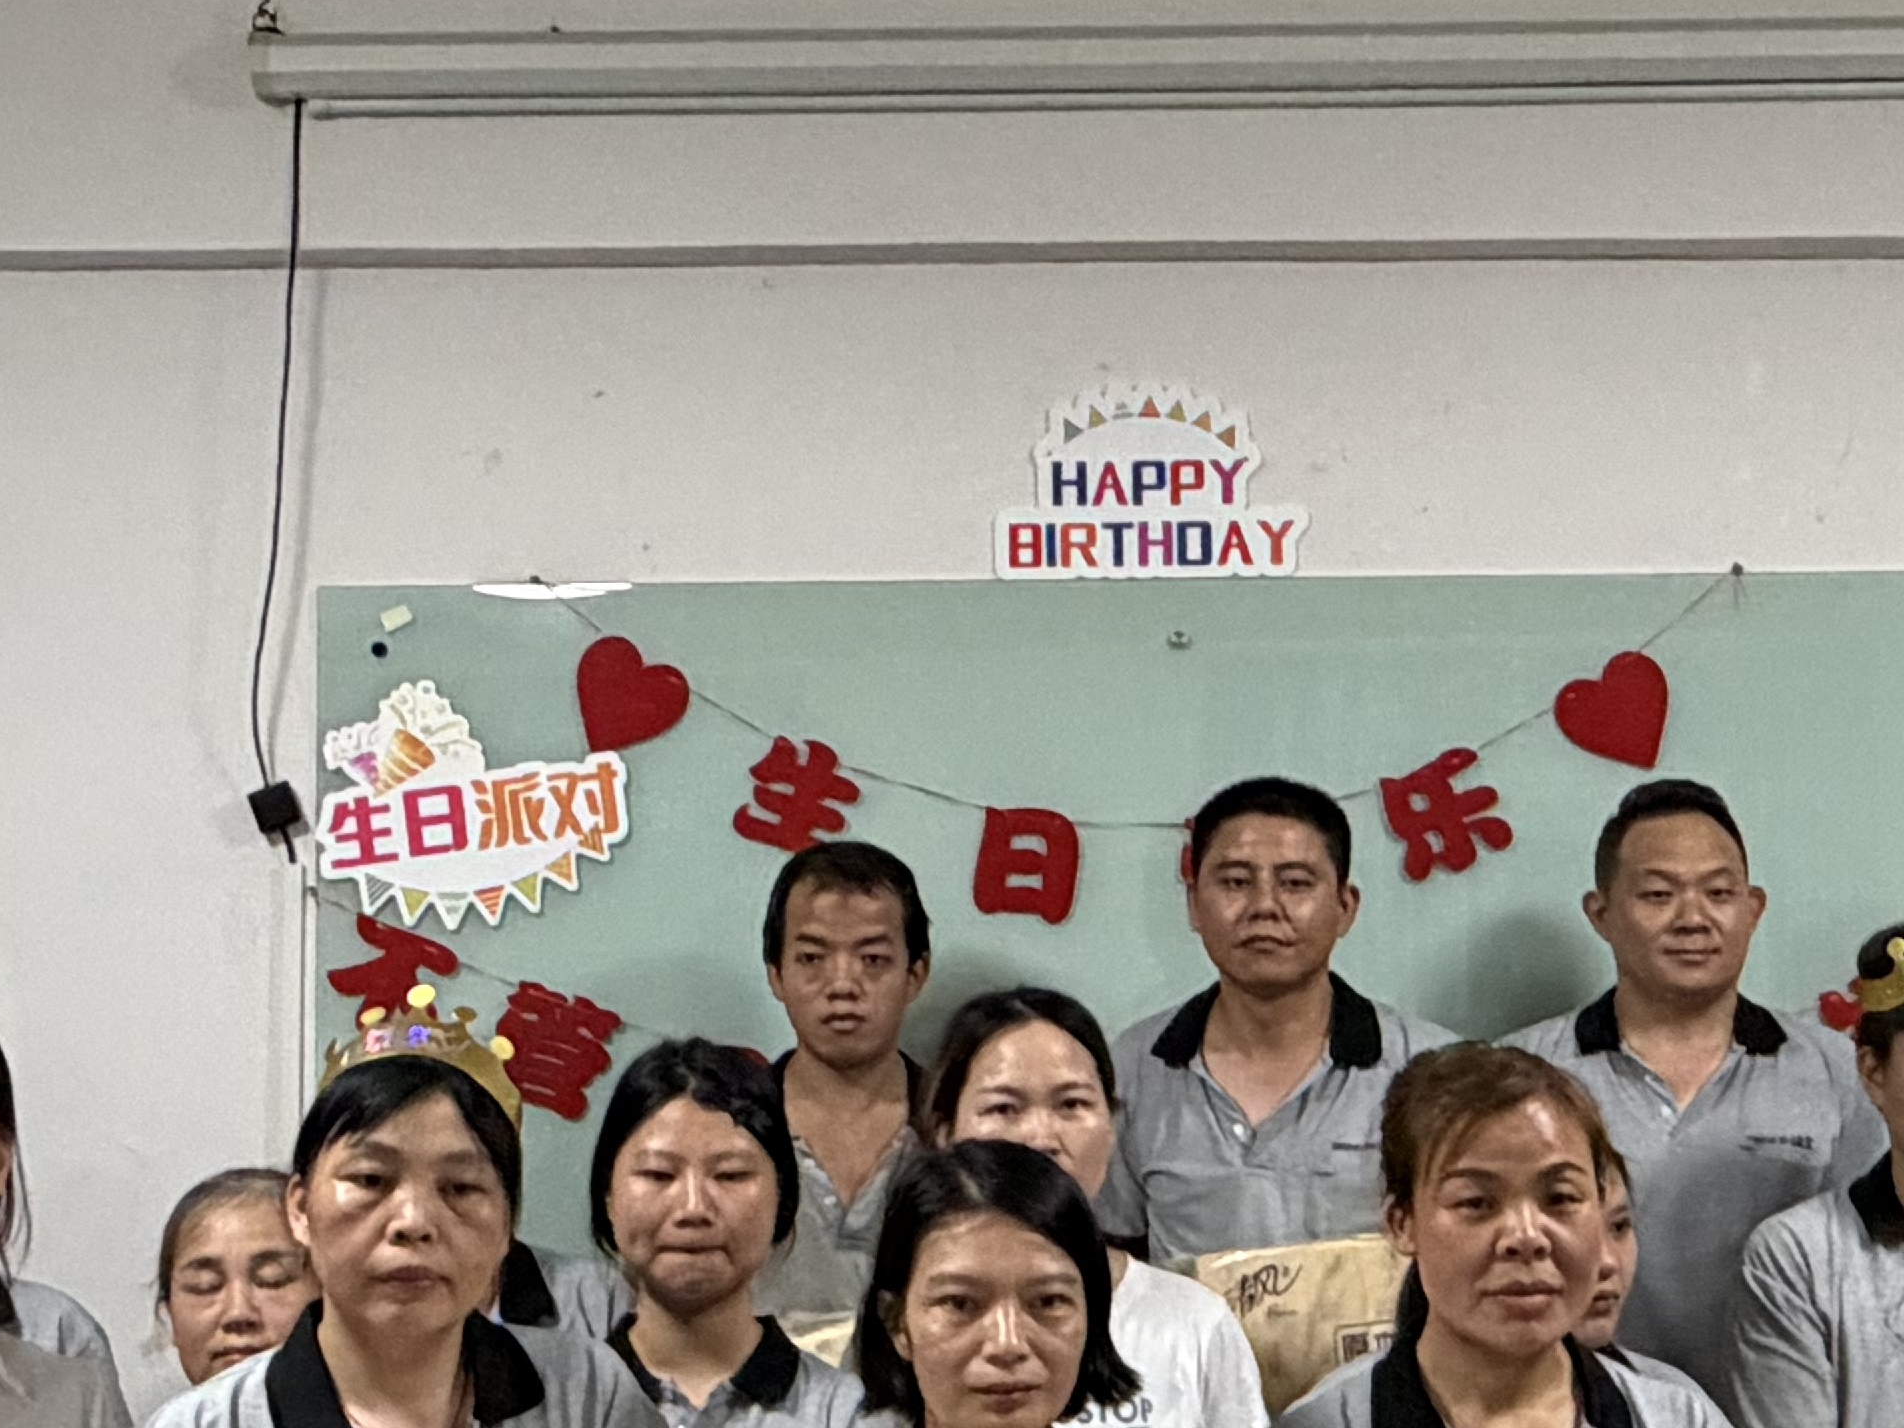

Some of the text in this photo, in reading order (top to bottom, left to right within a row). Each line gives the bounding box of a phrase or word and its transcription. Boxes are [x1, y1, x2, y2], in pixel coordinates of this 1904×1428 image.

[1051, 457, 1246, 509] HAPPY
[1008, 517, 1295, 569] BIRTHDAY
[328, 762, 620, 870] 生日派对
